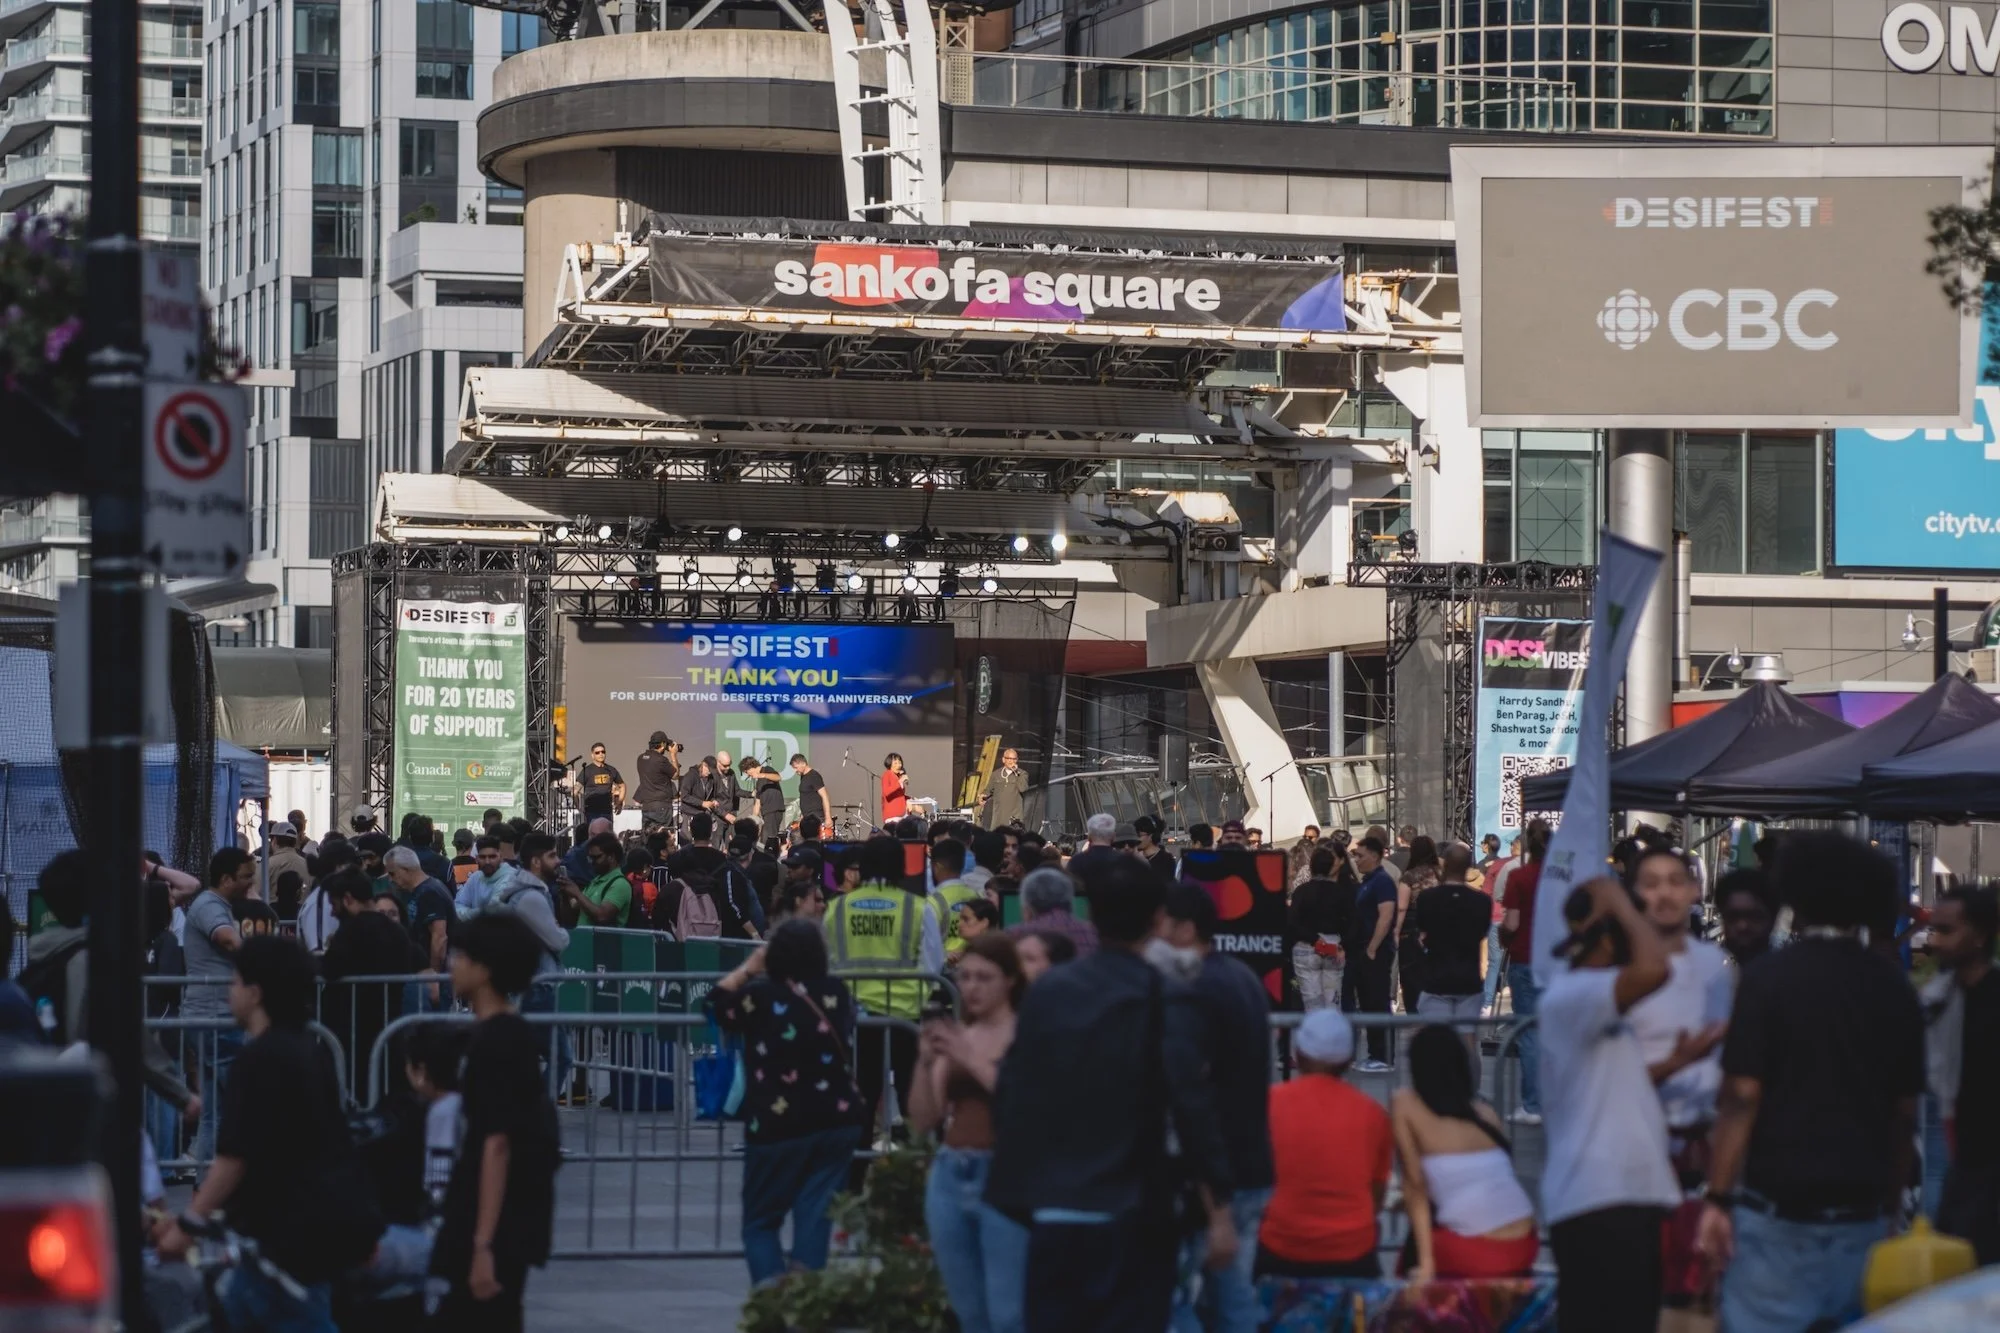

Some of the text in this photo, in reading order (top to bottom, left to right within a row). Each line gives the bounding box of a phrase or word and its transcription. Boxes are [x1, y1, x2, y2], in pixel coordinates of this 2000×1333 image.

[1615, 196, 1819, 229] DESIFEST
[773, 253, 1222, 315] sankofa square
[1668, 287, 1840, 351] CBC
[409, 608, 490, 625] DESIFEST
[691, 634, 829, 659] DESIFEST
[1484, 639, 1588, 669] DESI VIBES
[418, 656, 503, 681] THANK YOU
[686, 667, 839, 687] THANK YOU
[404, 684, 516, 710] FOR 20 YEARS
[610, 691, 913, 705] FOR SUPPORTING DESIFEST'S 20TH ANNIVERSARY
[1499, 695, 1534, 708] Harrdy
[409, 714, 510, 738] OF SUPPORT.
[1496, 709, 1514, 719] Ben
[1516, 710, 1548, 722] Parag,
[1491, 723, 1537, 734] Shashwat
[1519, 738, 1526, 748] &
[725, 730, 800, 781] TD
[406, 761, 452, 776] Canada
[850, 913, 896, 937] SECURITY
[1212, 933, 1283, 953] TRANCE
